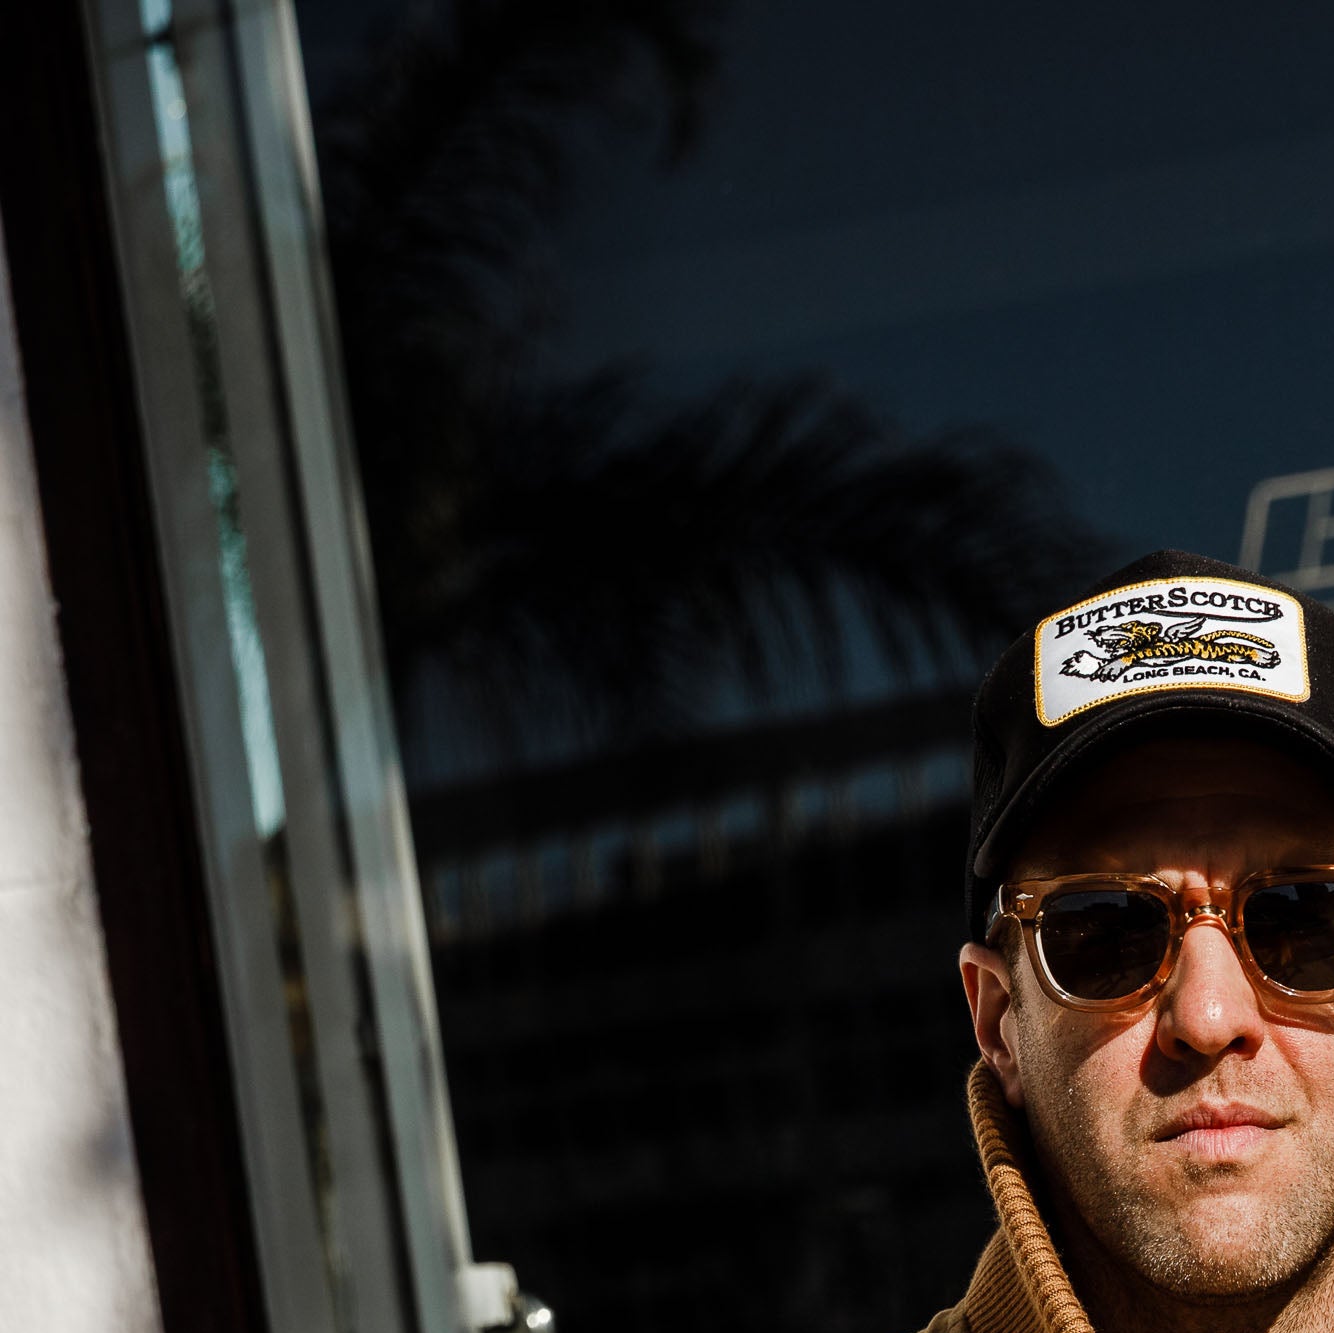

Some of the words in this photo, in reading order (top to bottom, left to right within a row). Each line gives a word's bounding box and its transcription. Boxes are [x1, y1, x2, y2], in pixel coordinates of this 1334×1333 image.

[1055, 587, 1284, 639] BUTTERSCOTCH
[1123, 667, 1169, 683] LONG
[1173, 665, 1235, 678] BEACH,
[1238, 667, 1267, 681] CA.
